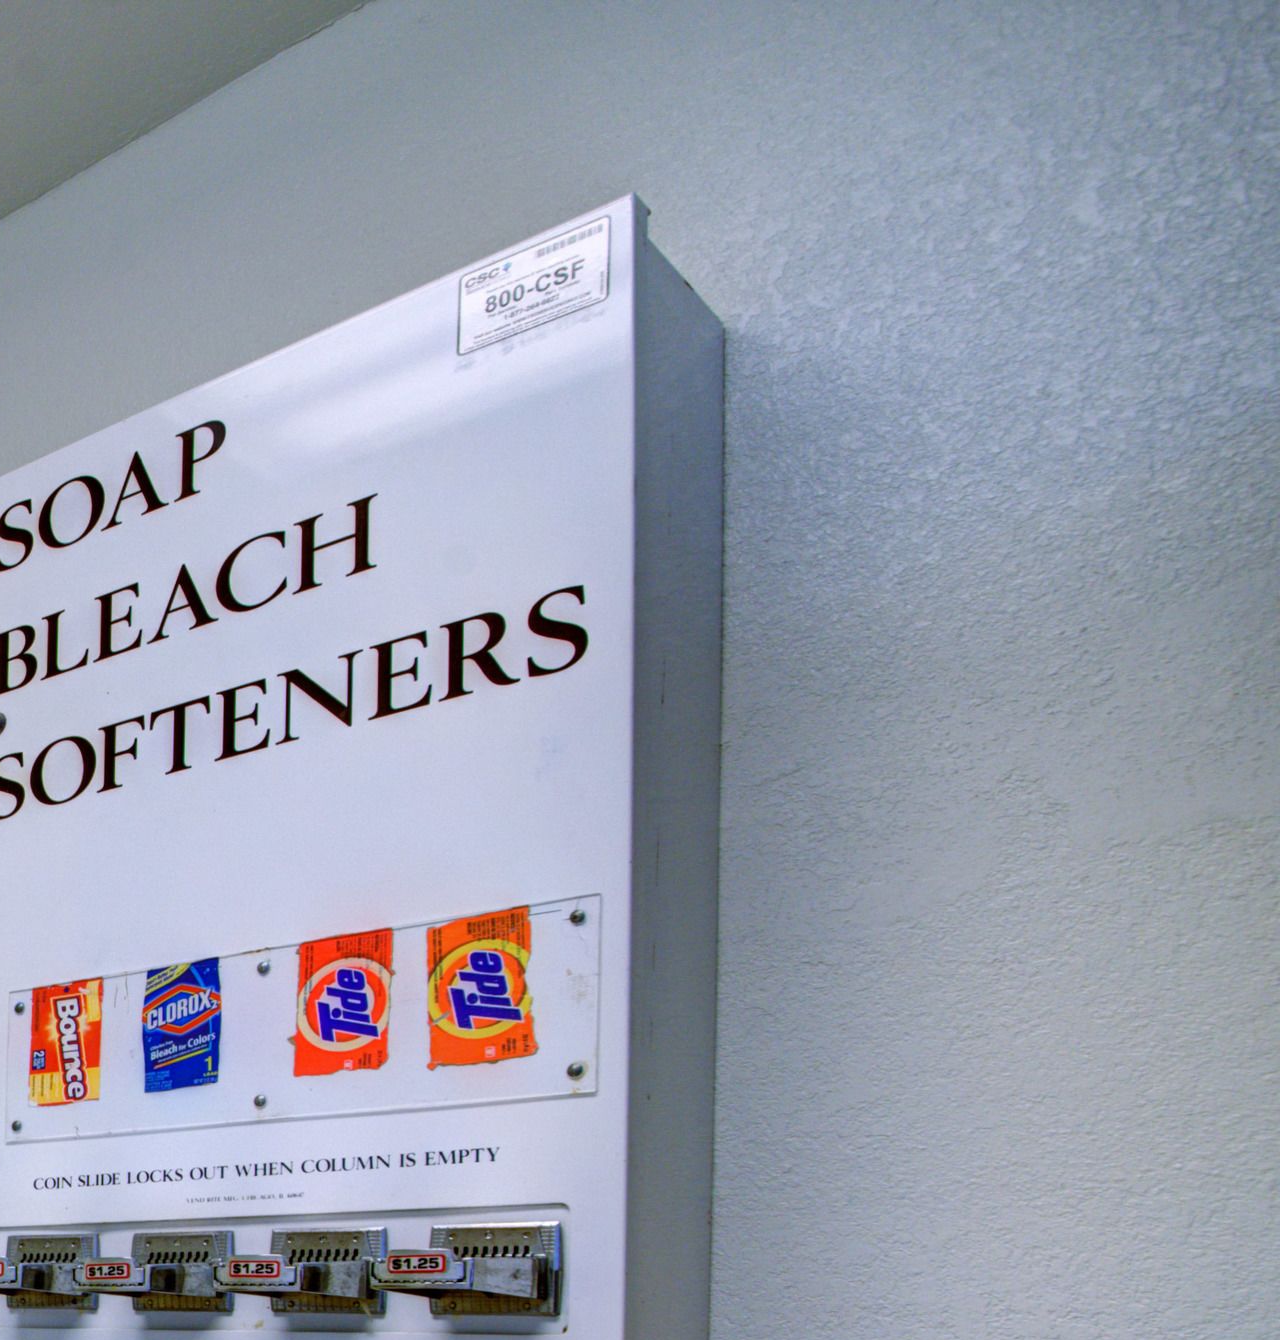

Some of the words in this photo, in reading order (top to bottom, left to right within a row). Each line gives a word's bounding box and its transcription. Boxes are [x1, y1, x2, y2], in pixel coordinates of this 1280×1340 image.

[465, 267, 500, 289] CSC
[485, 258, 585, 313] 800-CSF
[317, 968, 379, 1042] Tide
[449, 952, 523, 1030] Tide
[55, 997, 85, 1100] Bounce
[150, 1044, 178, 1061] Bleach
[187, 1032, 216, 1048] Colors
[204, 1056, 213, 1071] 1
[33, 1176, 73, 1190] COIN
[77, 1172, 121, 1188] SLIDE
[127, 1168, 183, 1185] LOCKS
[189, 1165, 228, 1180] OUT
[235, 1161, 293, 1178] WHEN
[301, 1155, 390, 1174] COLUMN
[399, 1152, 416, 1168] IS
[424, 1147, 500, 1166] EMPTY
[87, 1265, 125, 1276] $1.25
[233, 1263, 275, 1275] $1.25
[391, 1257, 440, 1271] $1.25
